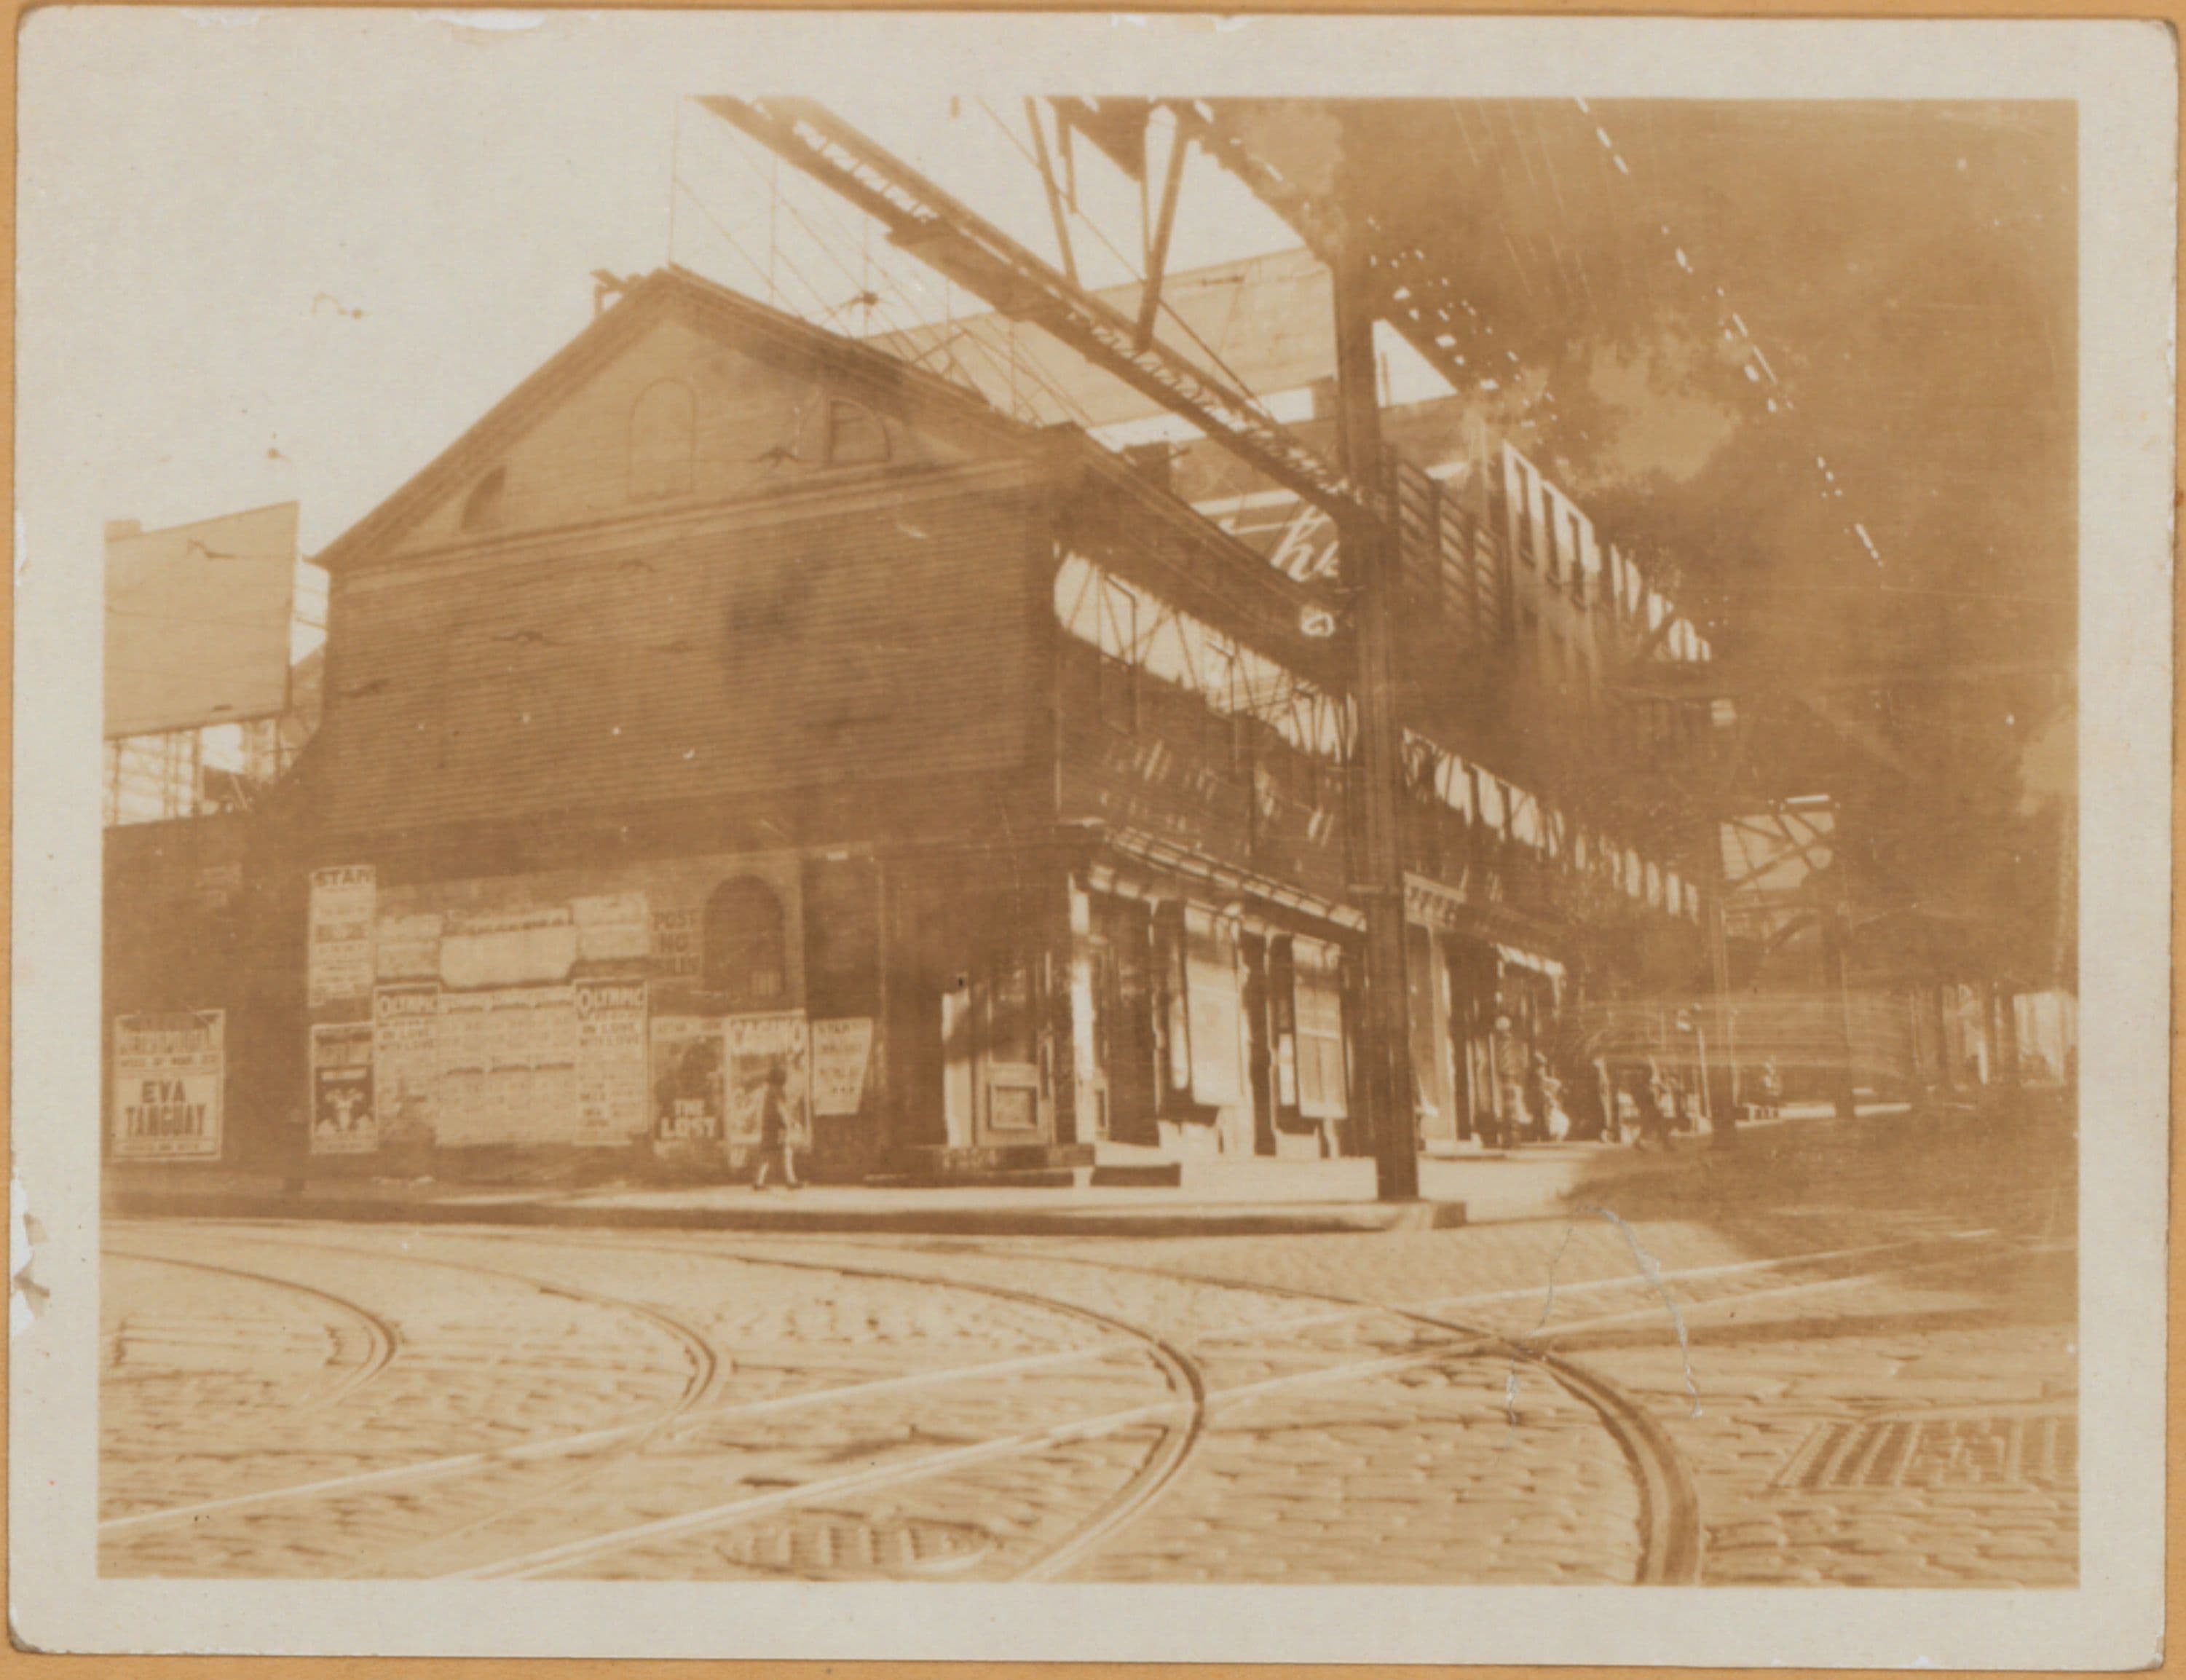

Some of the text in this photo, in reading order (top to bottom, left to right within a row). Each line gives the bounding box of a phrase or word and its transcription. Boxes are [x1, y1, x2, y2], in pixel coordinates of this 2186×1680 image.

[315, 869, 371, 886] STAR
[652, 910, 698, 931] POST
[660, 933, 689, 953] NO
[142, 1079, 186, 1103] EVA
[674, 1099, 705, 1116] THE
[660, 1117, 716, 1139] LOST
